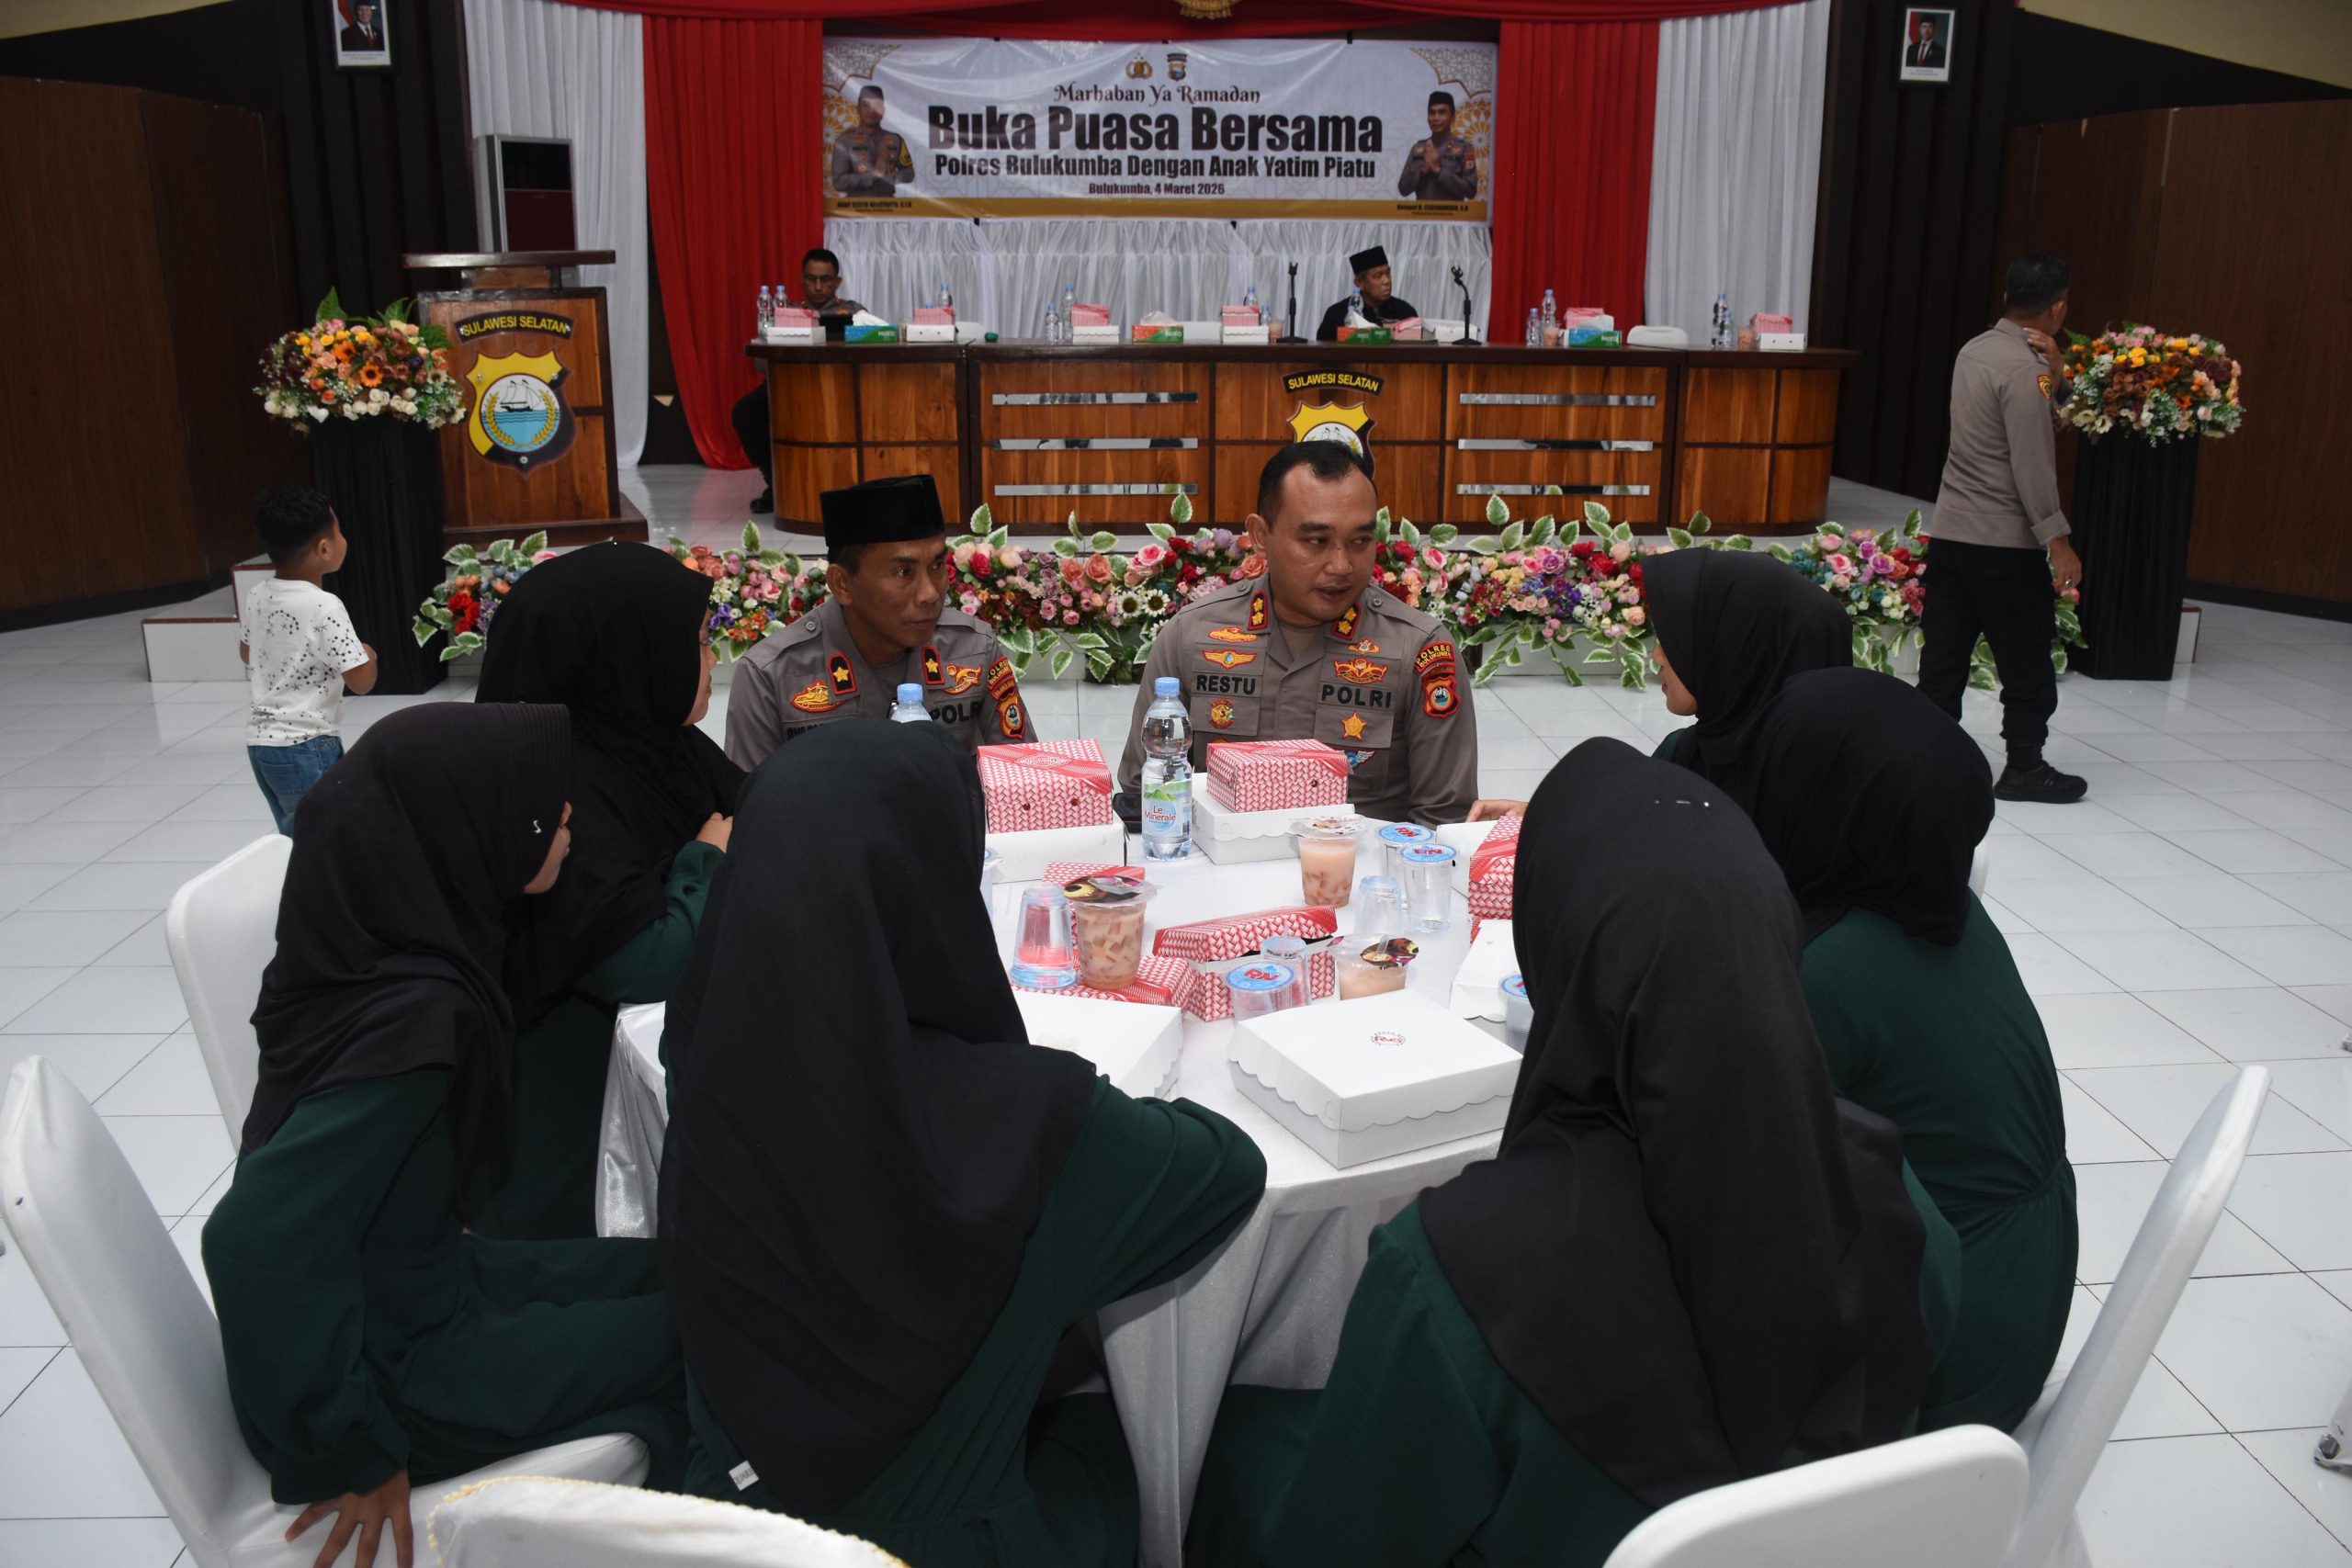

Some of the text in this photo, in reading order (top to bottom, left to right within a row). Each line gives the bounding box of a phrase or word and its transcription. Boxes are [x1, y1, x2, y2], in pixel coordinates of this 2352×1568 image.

[1054, 82, 1261, 107] Marhaban Ya Ramadan
[928, 106, 1383, 152] Buka Puasa Bersama
[1006, 154, 1122, 176] Bulukumba
[1127, 155, 1204, 178] Dengan
[1209, 155, 1259, 177] Anak
[1263, 156, 1319, 177] Yatim
[1324, 156, 1375, 178] Piatu
[1089, 184, 1225, 196] Bulukumba, 4 Maret 2026
[462, 316, 569, 337] SULAWESI SELATAN
[1288, 373, 1379, 392] SULAWESI SELATAN
[1416, 645, 1451, 665] POLRES
[1196, 674, 1256, 695] RESTU
[1321, 684, 1392, 708] POLRI
[1145, 811, 1176, 821] Minerale
[1153, 806, 1163, 814] Le
